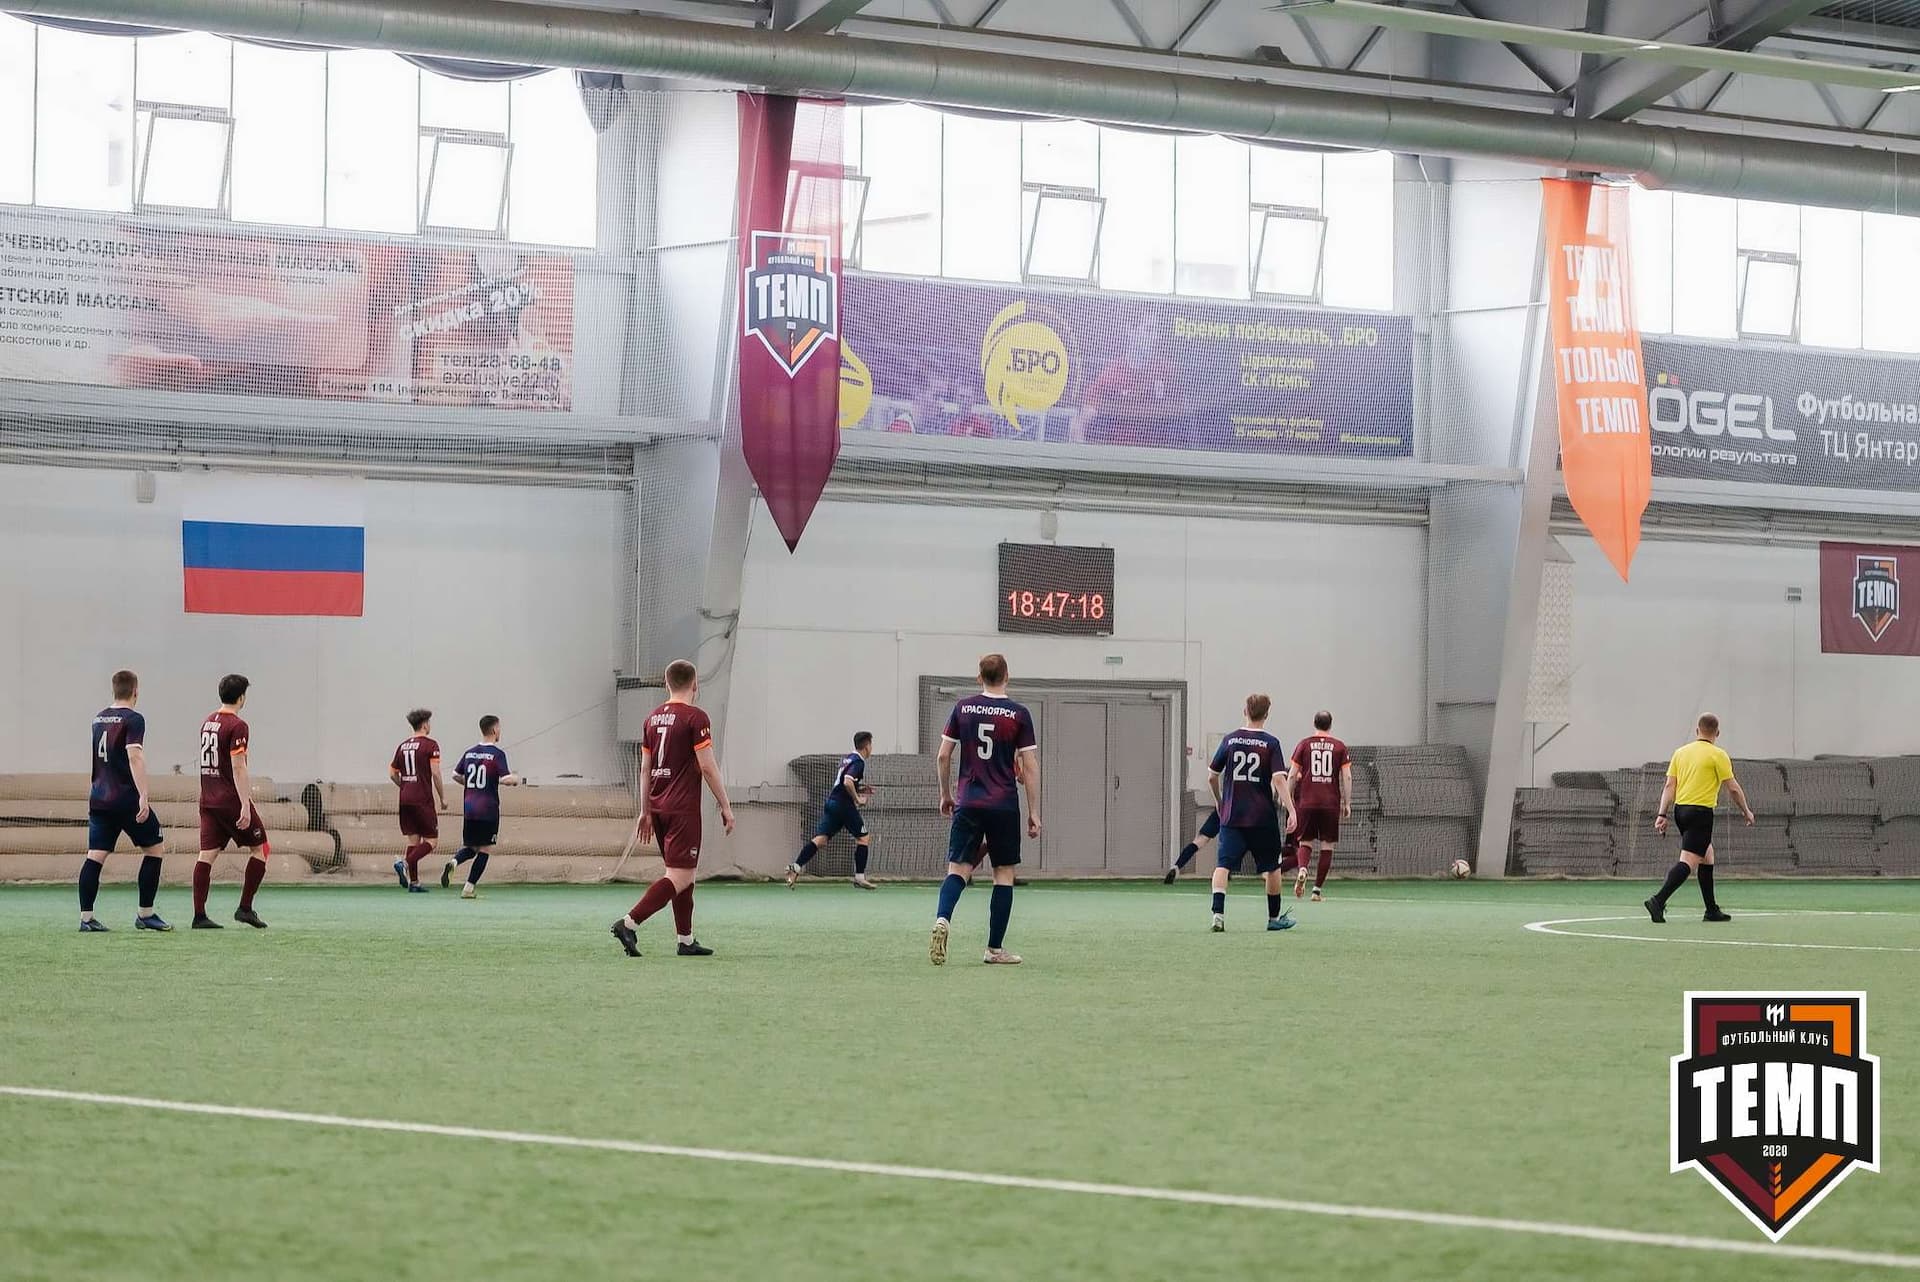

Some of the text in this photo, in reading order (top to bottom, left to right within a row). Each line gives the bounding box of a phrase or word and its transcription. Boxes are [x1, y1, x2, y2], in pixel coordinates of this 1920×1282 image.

[488, 279, 542, 313] 20%
[755, 273, 827, 324] ТЕМП
[1174, 317, 1230, 340] Время
[1235, 321, 1331, 348] побеждать,
[1560, 347, 1640, 385] ТОЛЬКО
[1576, 397, 1640, 434] ТЕМП!
[1710, 449, 1798, 465] результата
[1820, 430, 1849, 462] ТЦ
[1008, 591, 1104, 619] 18:47:18
[1858, 580, 1895, 611] ТЕМП
[961, 704, 1016, 719] КРАСНОЯРСК
[98, 730, 108, 762] 4
[201, 732, 219, 767] 23
[656, 727, 667, 767] 7
[977, 723, 995, 760] 5
[402, 750, 416, 776] 11
[467, 763, 487, 789] 20
[1233, 751, 1260, 783] 22
[1311, 750, 1333, 777] 60
